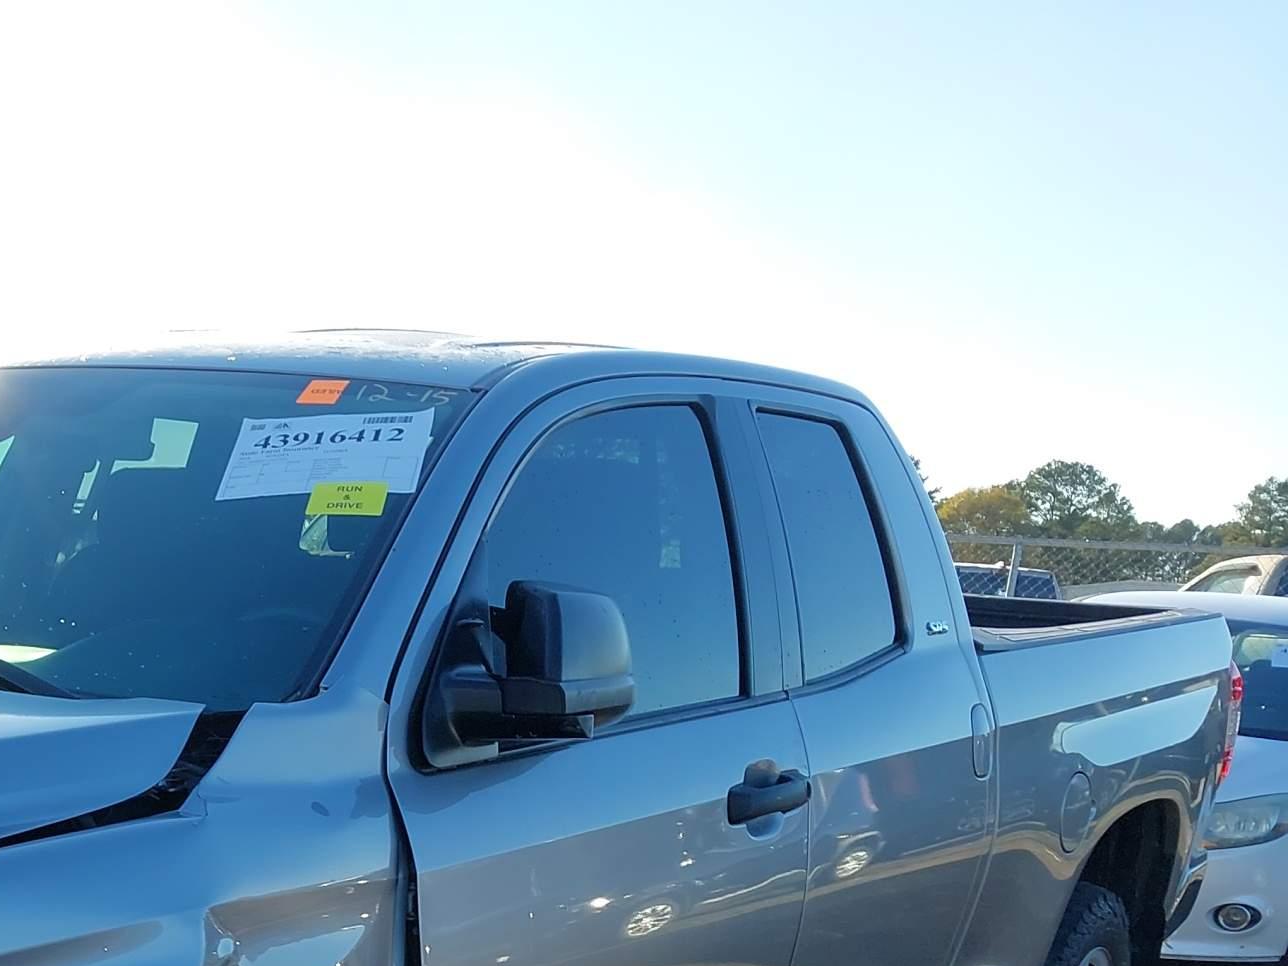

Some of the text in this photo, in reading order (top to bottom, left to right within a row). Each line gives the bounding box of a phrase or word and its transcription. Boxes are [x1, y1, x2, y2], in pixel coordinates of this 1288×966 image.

[253, 427, 405, 449] 43916412
[336, 485, 363, 493] RUN
[326, 502, 363, 510] DRIVE
